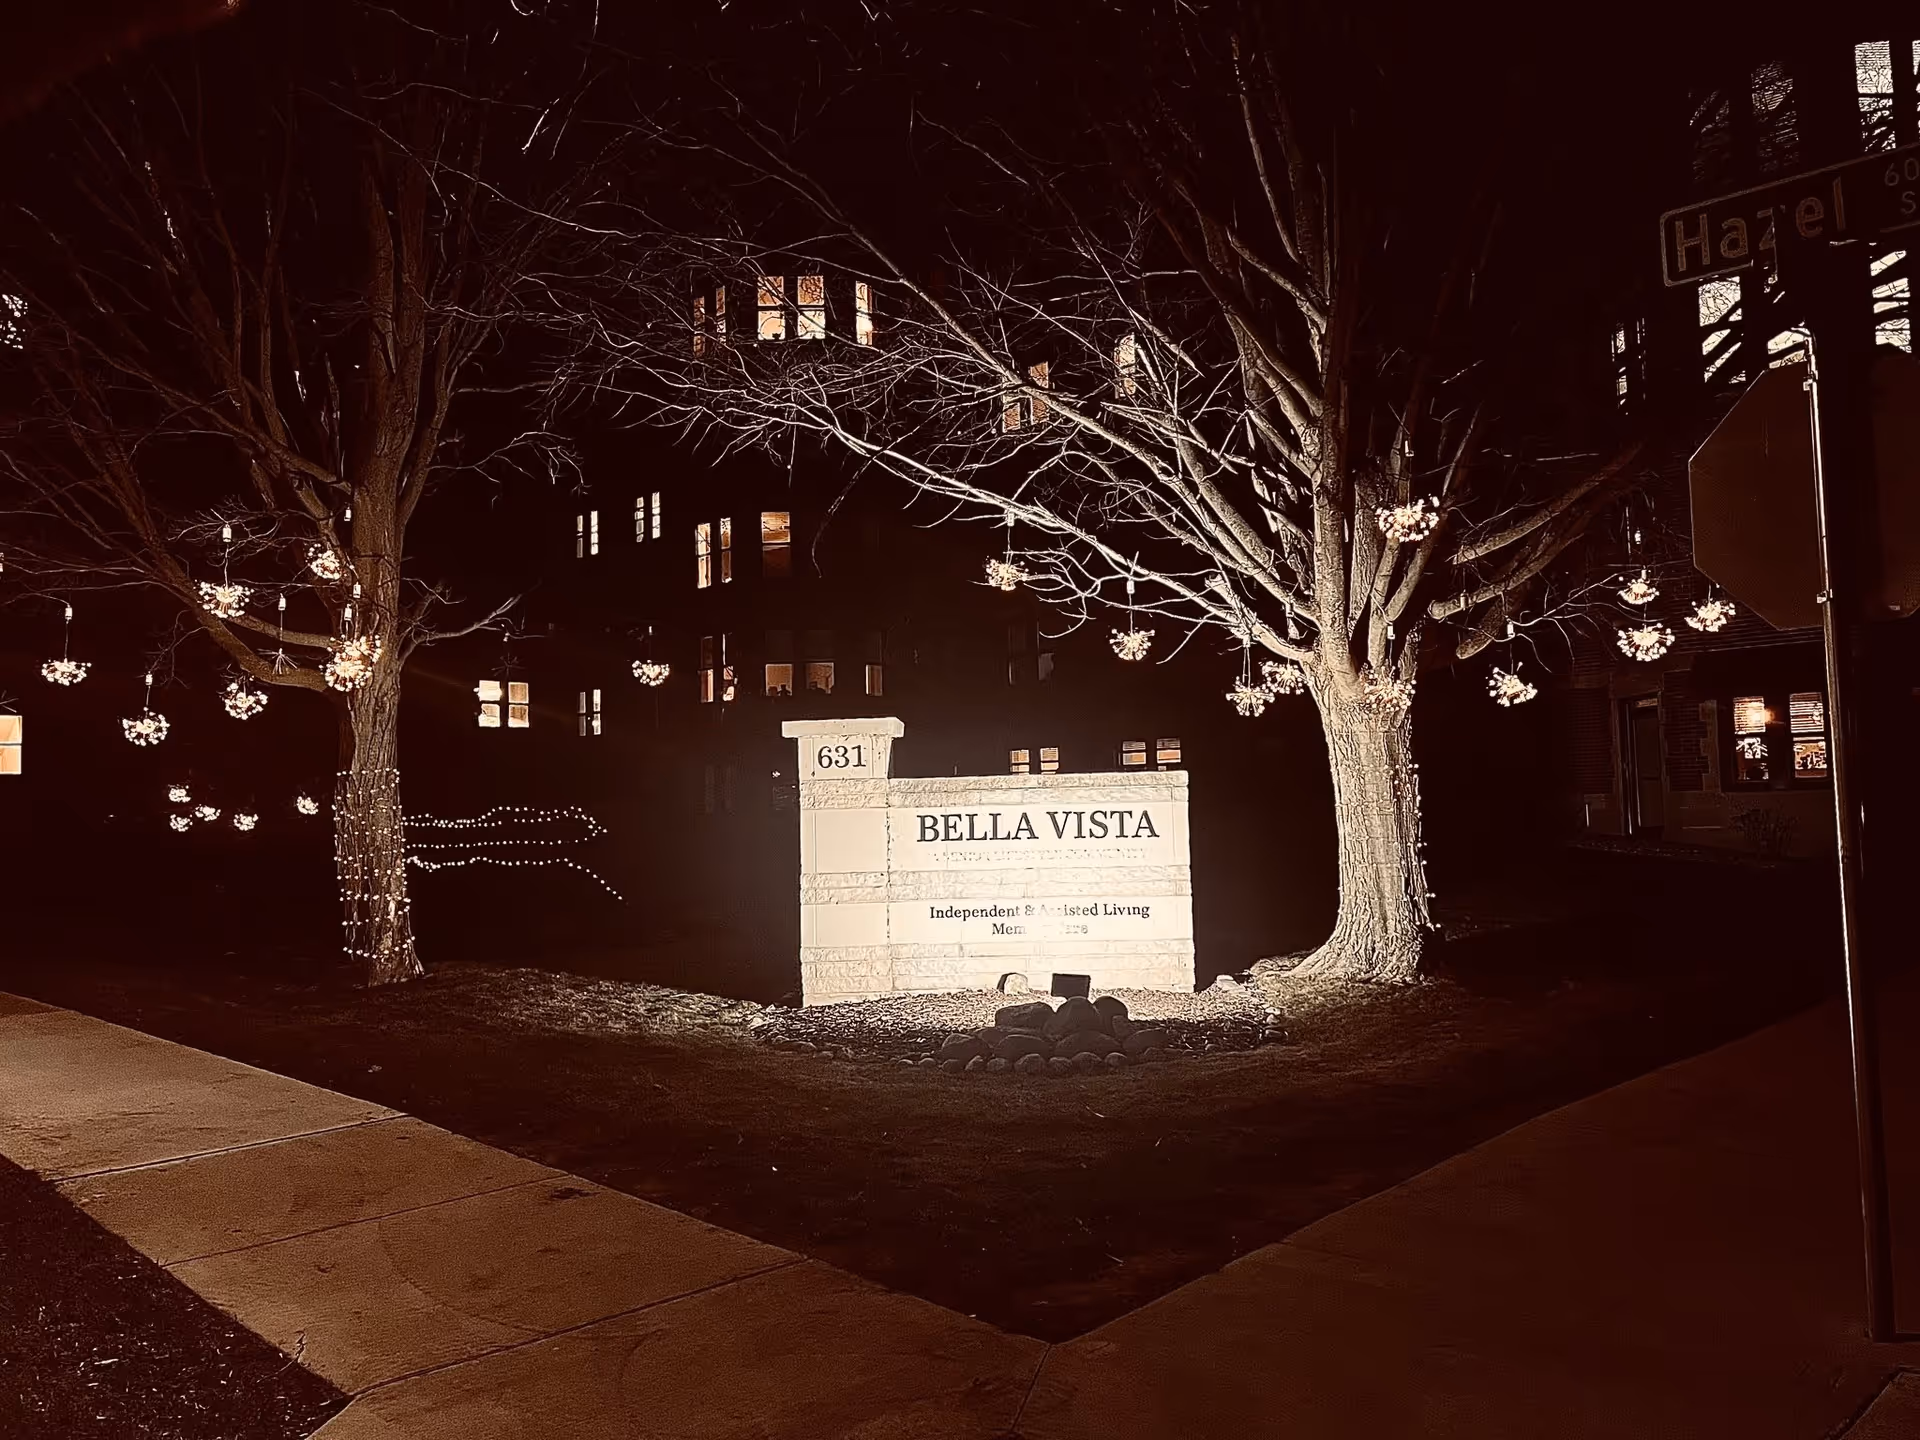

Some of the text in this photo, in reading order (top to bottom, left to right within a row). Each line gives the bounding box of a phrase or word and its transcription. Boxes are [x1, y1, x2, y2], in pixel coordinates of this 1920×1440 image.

[1675, 176, 1846, 272] Hazel
[817, 744, 867, 769] 631
[916, 810, 1160, 842] BELLA VISTA
[929, 904, 1020, 921] Independent
[1039, 902, 1099, 917] Aisted
[1102, 902, 1151, 919] Living
